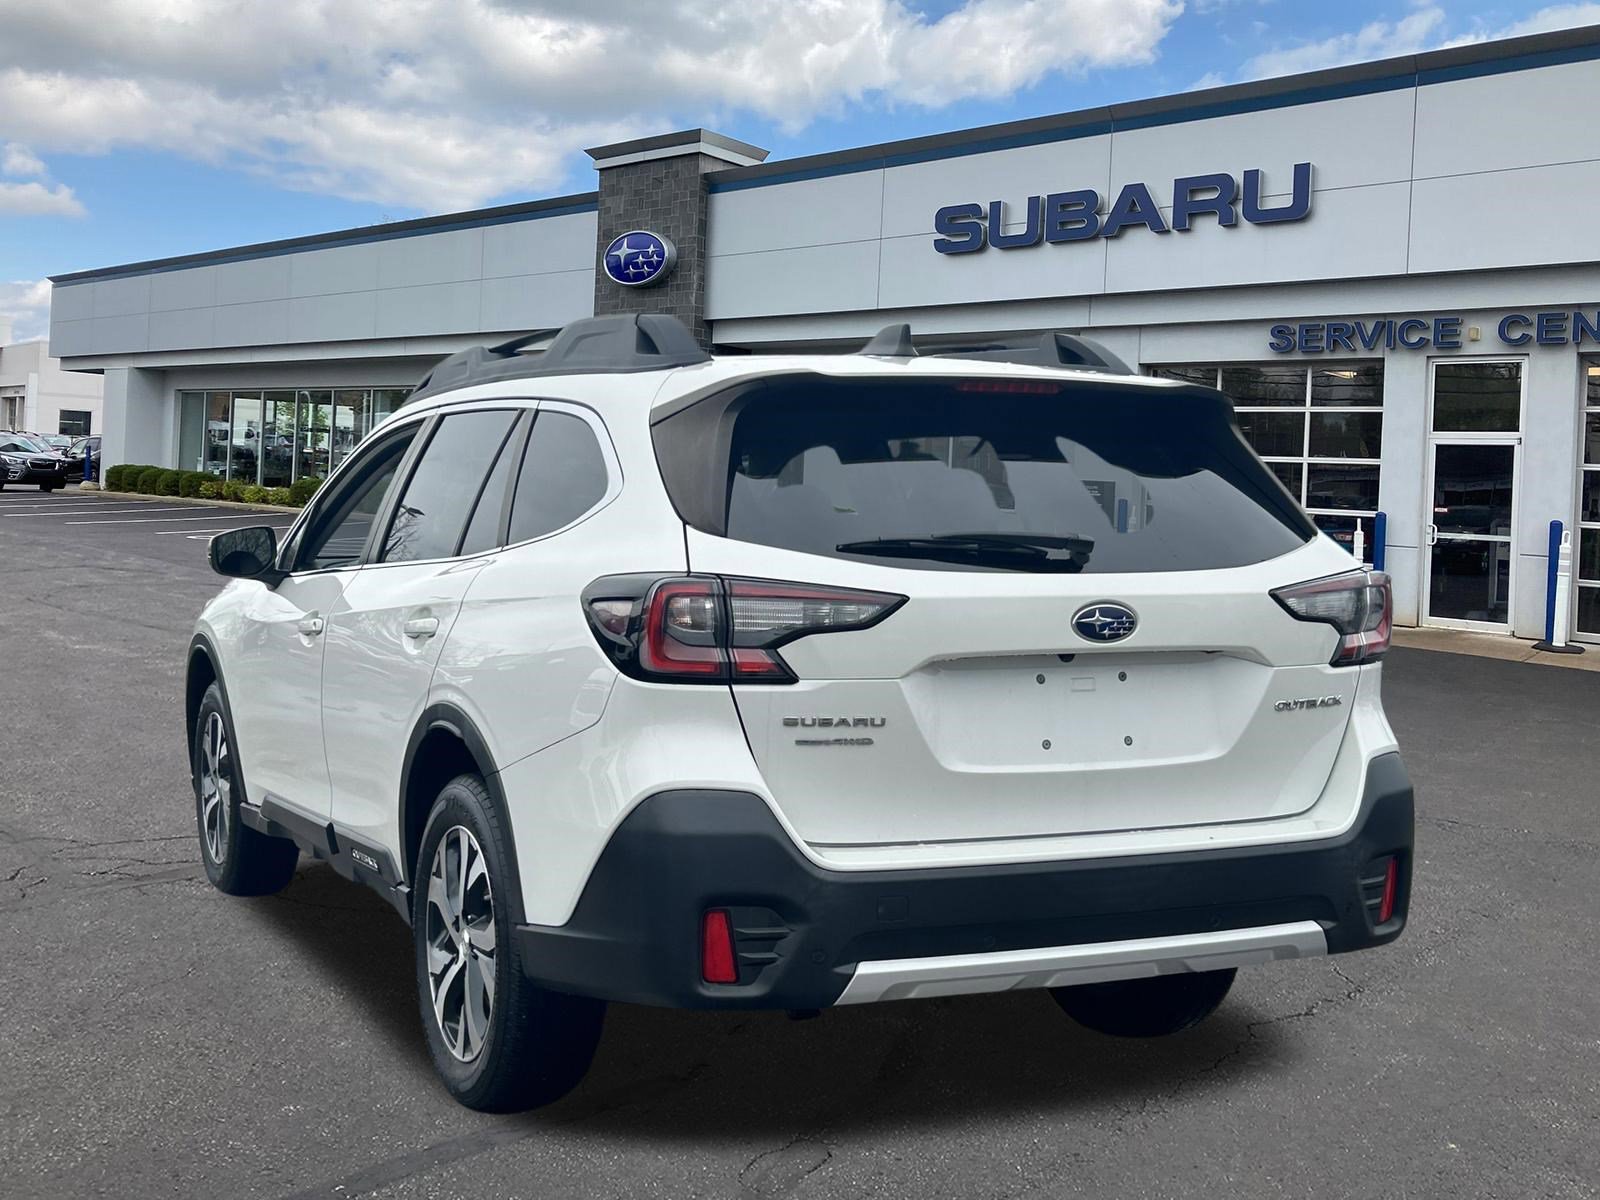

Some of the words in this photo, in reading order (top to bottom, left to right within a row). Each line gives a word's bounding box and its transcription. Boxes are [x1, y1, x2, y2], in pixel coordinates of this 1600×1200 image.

[933, 162, 1312, 254] SUBARU
[1269, 317, 1463, 352] SERVICE
[1498, 311, 1600, 346] CEN
[782, 716, 886, 727] SUBARU
